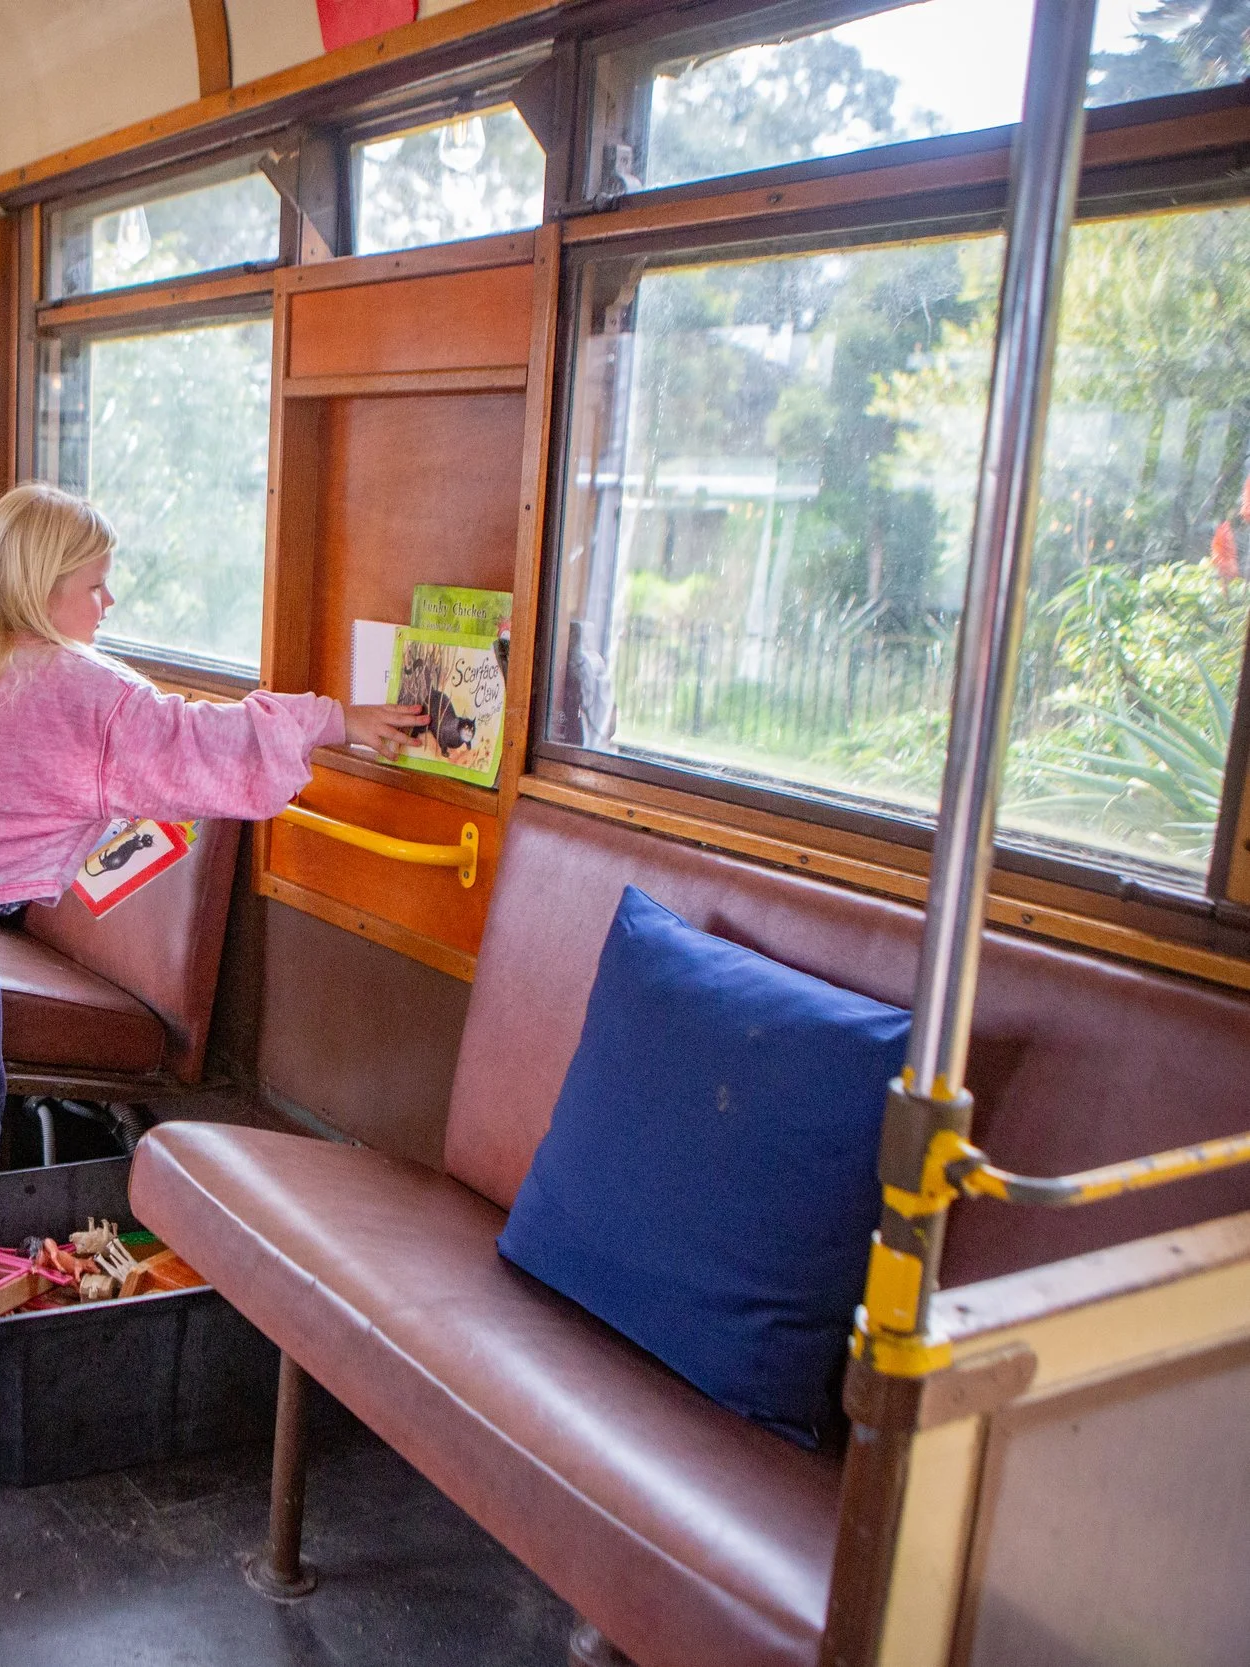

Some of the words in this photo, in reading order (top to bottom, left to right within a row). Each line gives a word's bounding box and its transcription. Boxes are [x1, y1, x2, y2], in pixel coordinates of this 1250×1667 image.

[452, 602, 487, 618] Chicken
[451, 657, 499, 694] Scarface
[474, 682, 499, 707] Claw
